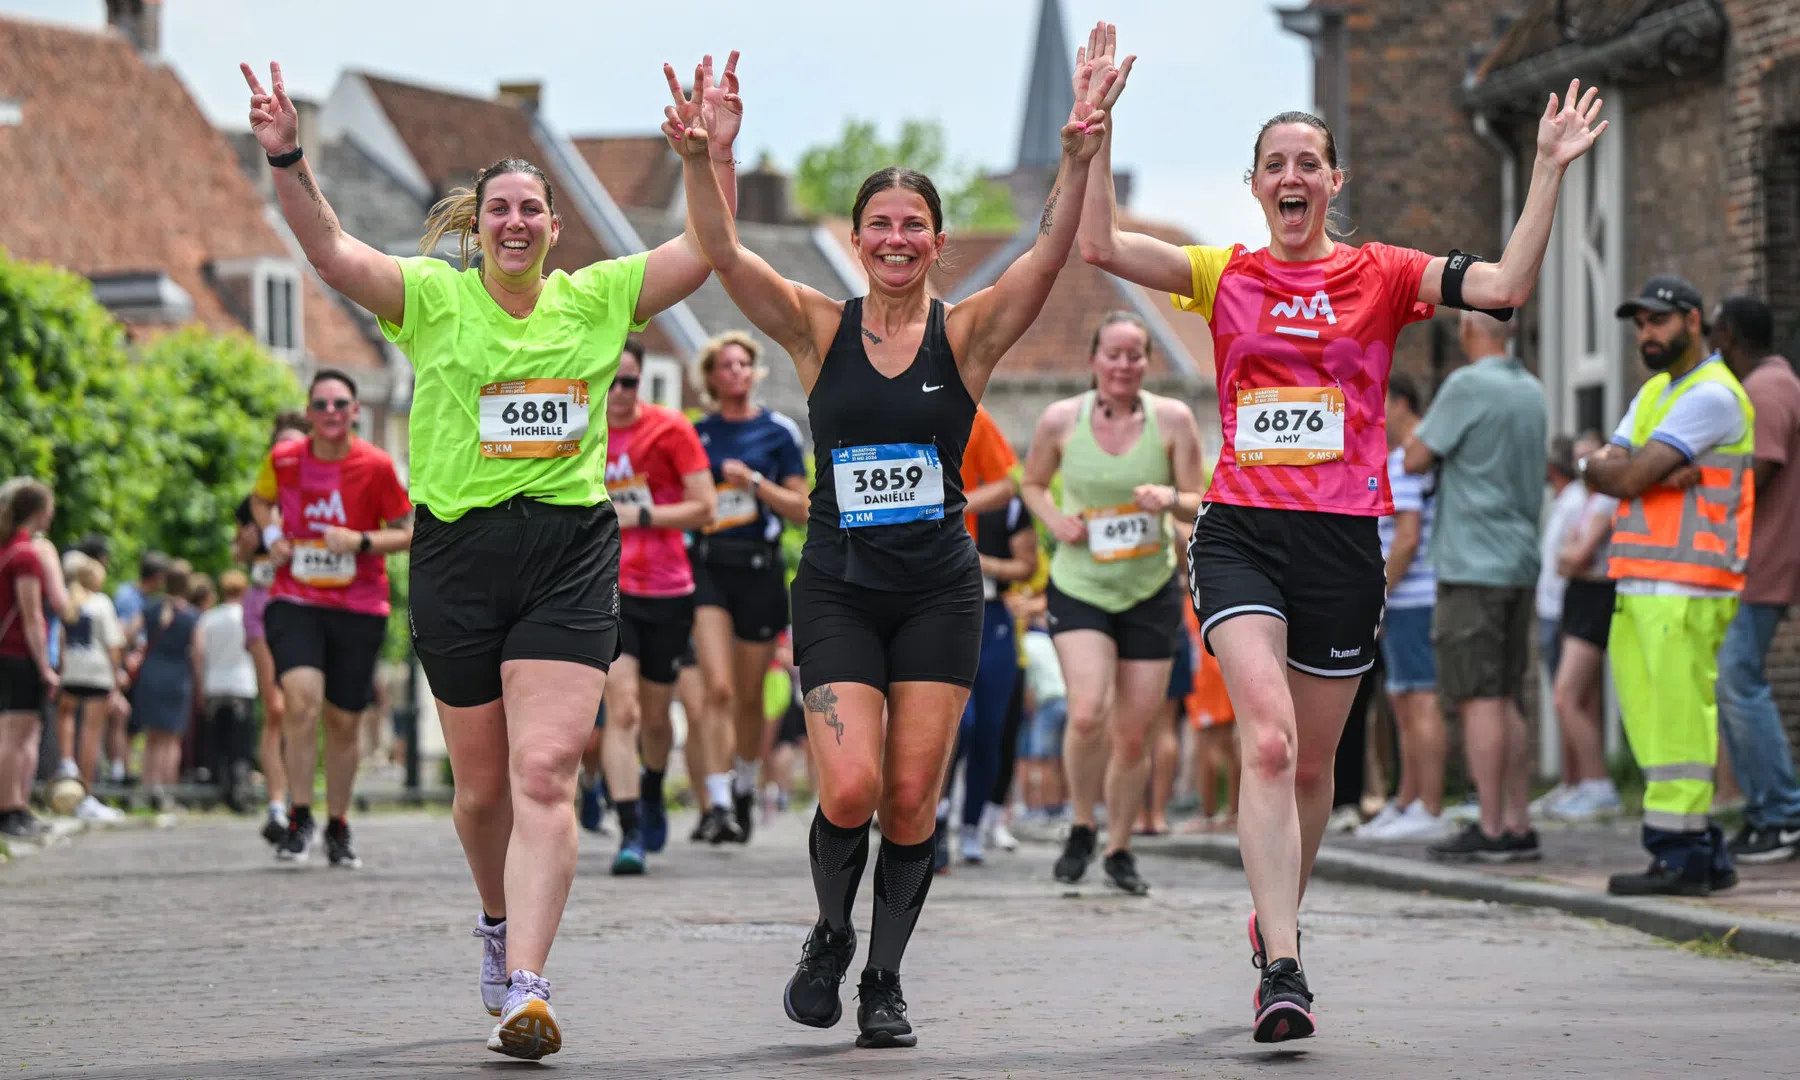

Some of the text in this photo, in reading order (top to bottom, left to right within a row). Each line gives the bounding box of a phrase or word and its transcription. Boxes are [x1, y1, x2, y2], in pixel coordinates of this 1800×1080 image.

[502, 400, 568, 424] 6881
[1254, 409, 1324, 432] 6876
[510, 426, 563, 436] MICHELLE
[1274, 434, 1301, 443] AMY
[495, 443, 512, 454] KM
[1241, 451, 1263, 461] 5 KM
[1316, 451, 1338, 461] MSA
[853, 465, 923, 492] 3859
[863, 490, 915, 505] DANIËLLE
[856, 512, 874, 522] KM
[1330, 646, 1361, 658] hummel
